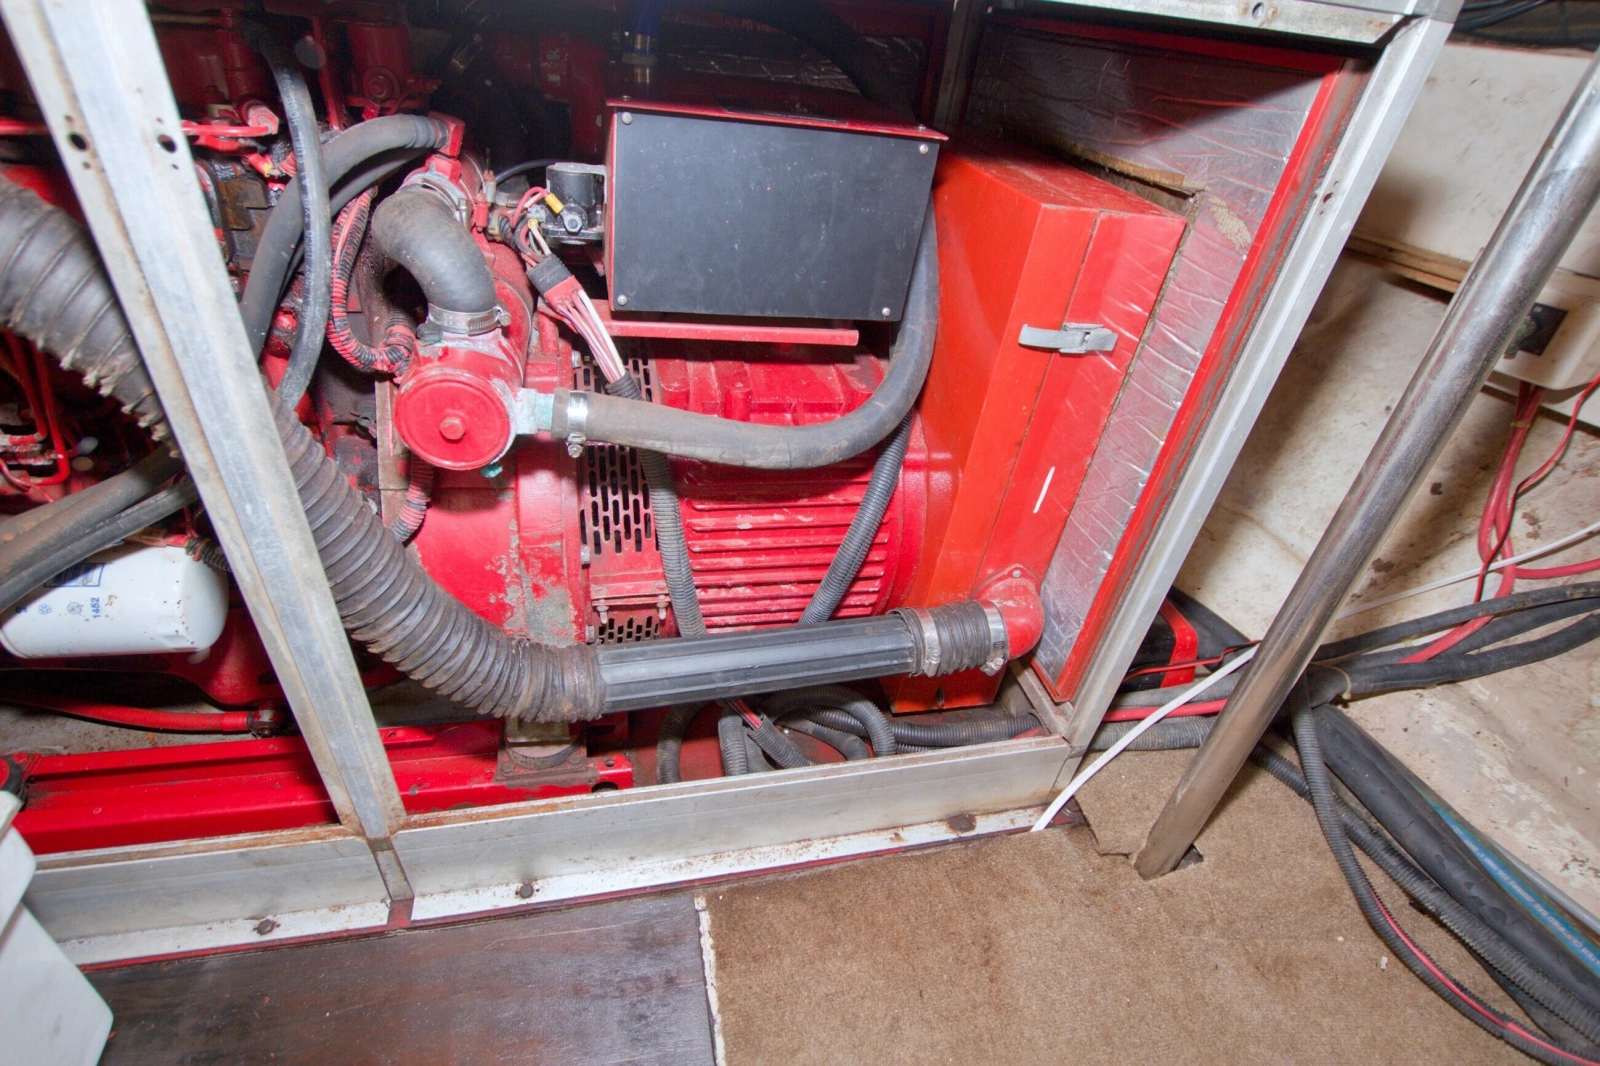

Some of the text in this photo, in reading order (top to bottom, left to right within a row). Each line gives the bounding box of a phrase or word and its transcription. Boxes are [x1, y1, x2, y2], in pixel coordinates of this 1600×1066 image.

[287, 92, 300, 126] HOSE
[295, 131, 306, 164] FUEL
[302, 192, 312, 224] TYPE
[305, 229, 315, 259] USCG
[91, 597, 101, 618] 1452
[1547, 915, 1583, 948] CERTIFIED
